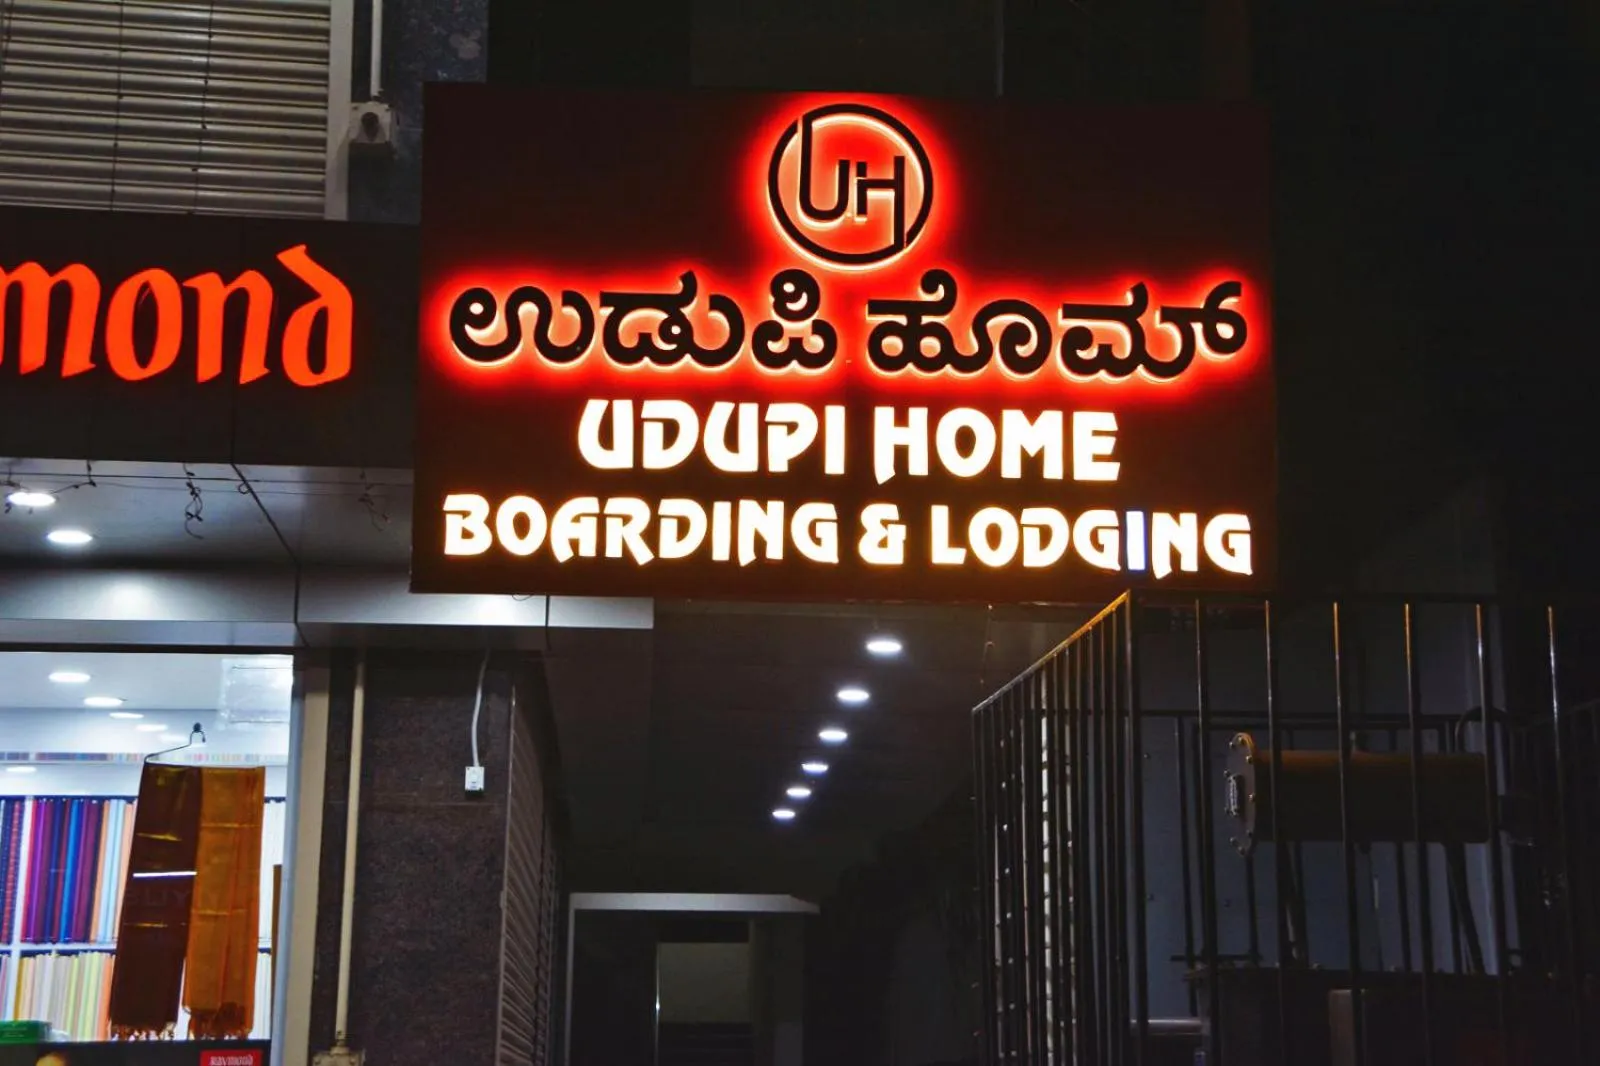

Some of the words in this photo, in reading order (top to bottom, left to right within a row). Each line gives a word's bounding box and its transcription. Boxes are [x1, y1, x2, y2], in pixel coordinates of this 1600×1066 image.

[449, 268, 838, 370] ಉಡುಪಿ
[577, 399, 846, 475] UDUPI
[873, 406, 1121, 485] HOME
[443, 493, 839, 567] BOARDING
[858, 503, 907, 566] &
[930, 504, 1253, 580] LODGING
